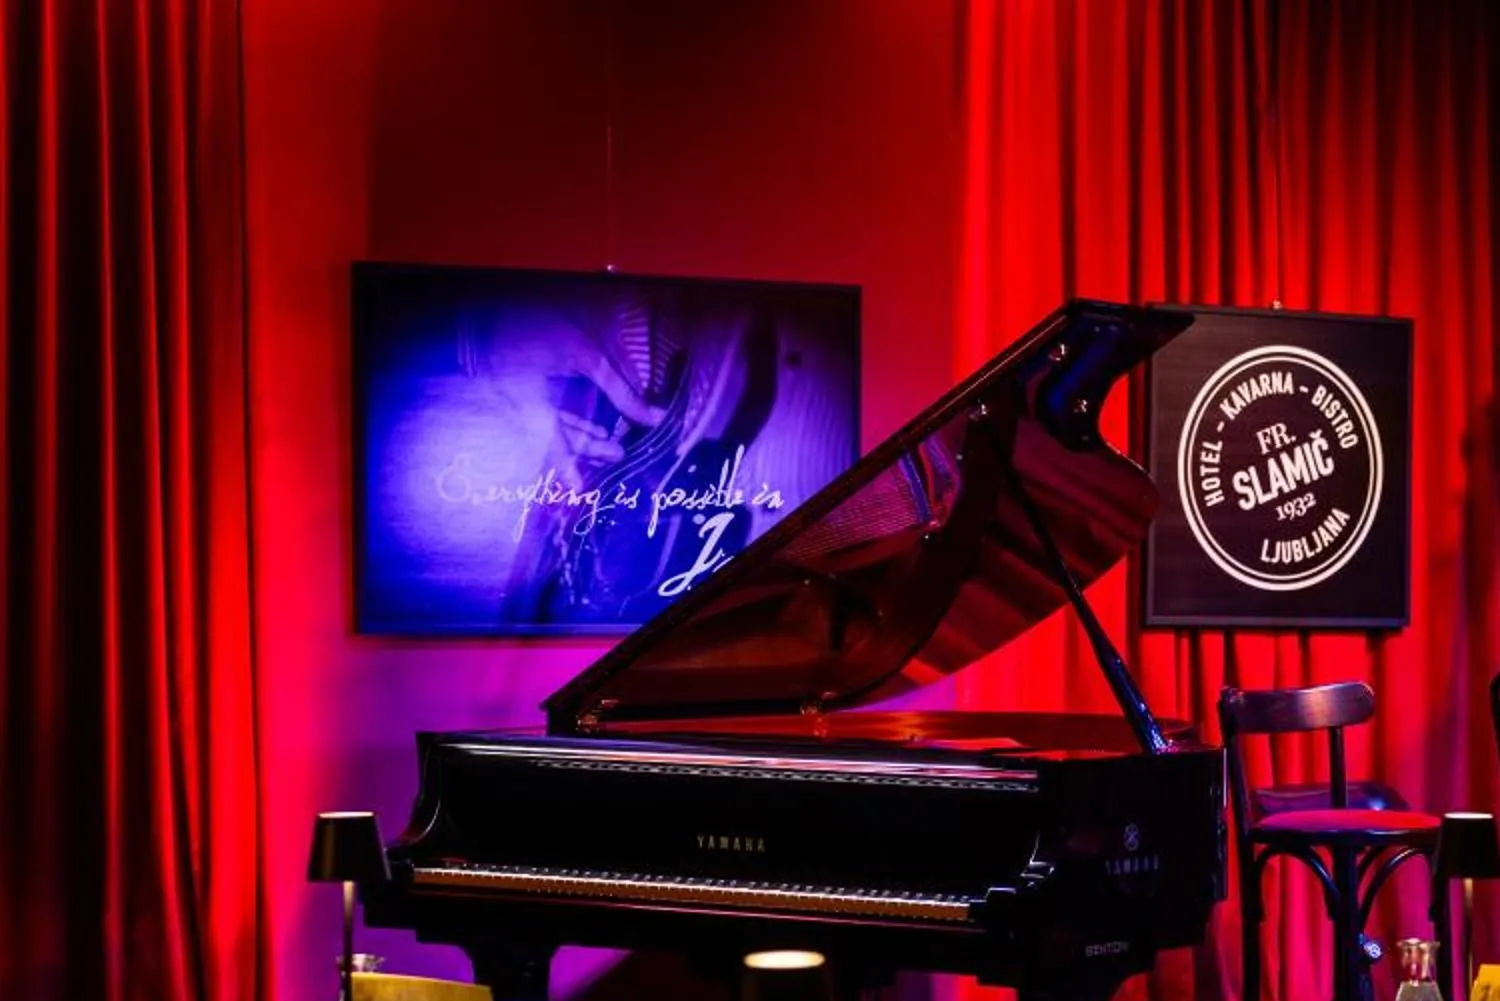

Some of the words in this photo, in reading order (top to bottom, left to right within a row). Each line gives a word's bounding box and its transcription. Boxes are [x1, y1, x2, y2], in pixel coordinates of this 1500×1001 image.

[1200, 440, 1225, 507] HOTEL
[1219, 371, 1294, 420] KAVARNA
[1311, 384, 1359, 449] BISTRO
[1256, 422, 1297, 455] FR.
[614, 482, 641, 509] is
[647, 444, 745, 538] possible
[751, 483, 785, 509] in
[1231, 428, 1335, 511] SLAMIČ
[1274, 492, 1317, 521] 1932
[1260, 507, 1351, 564] LJUBLJANA
[696, 832, 766, 853] YAMAHA
